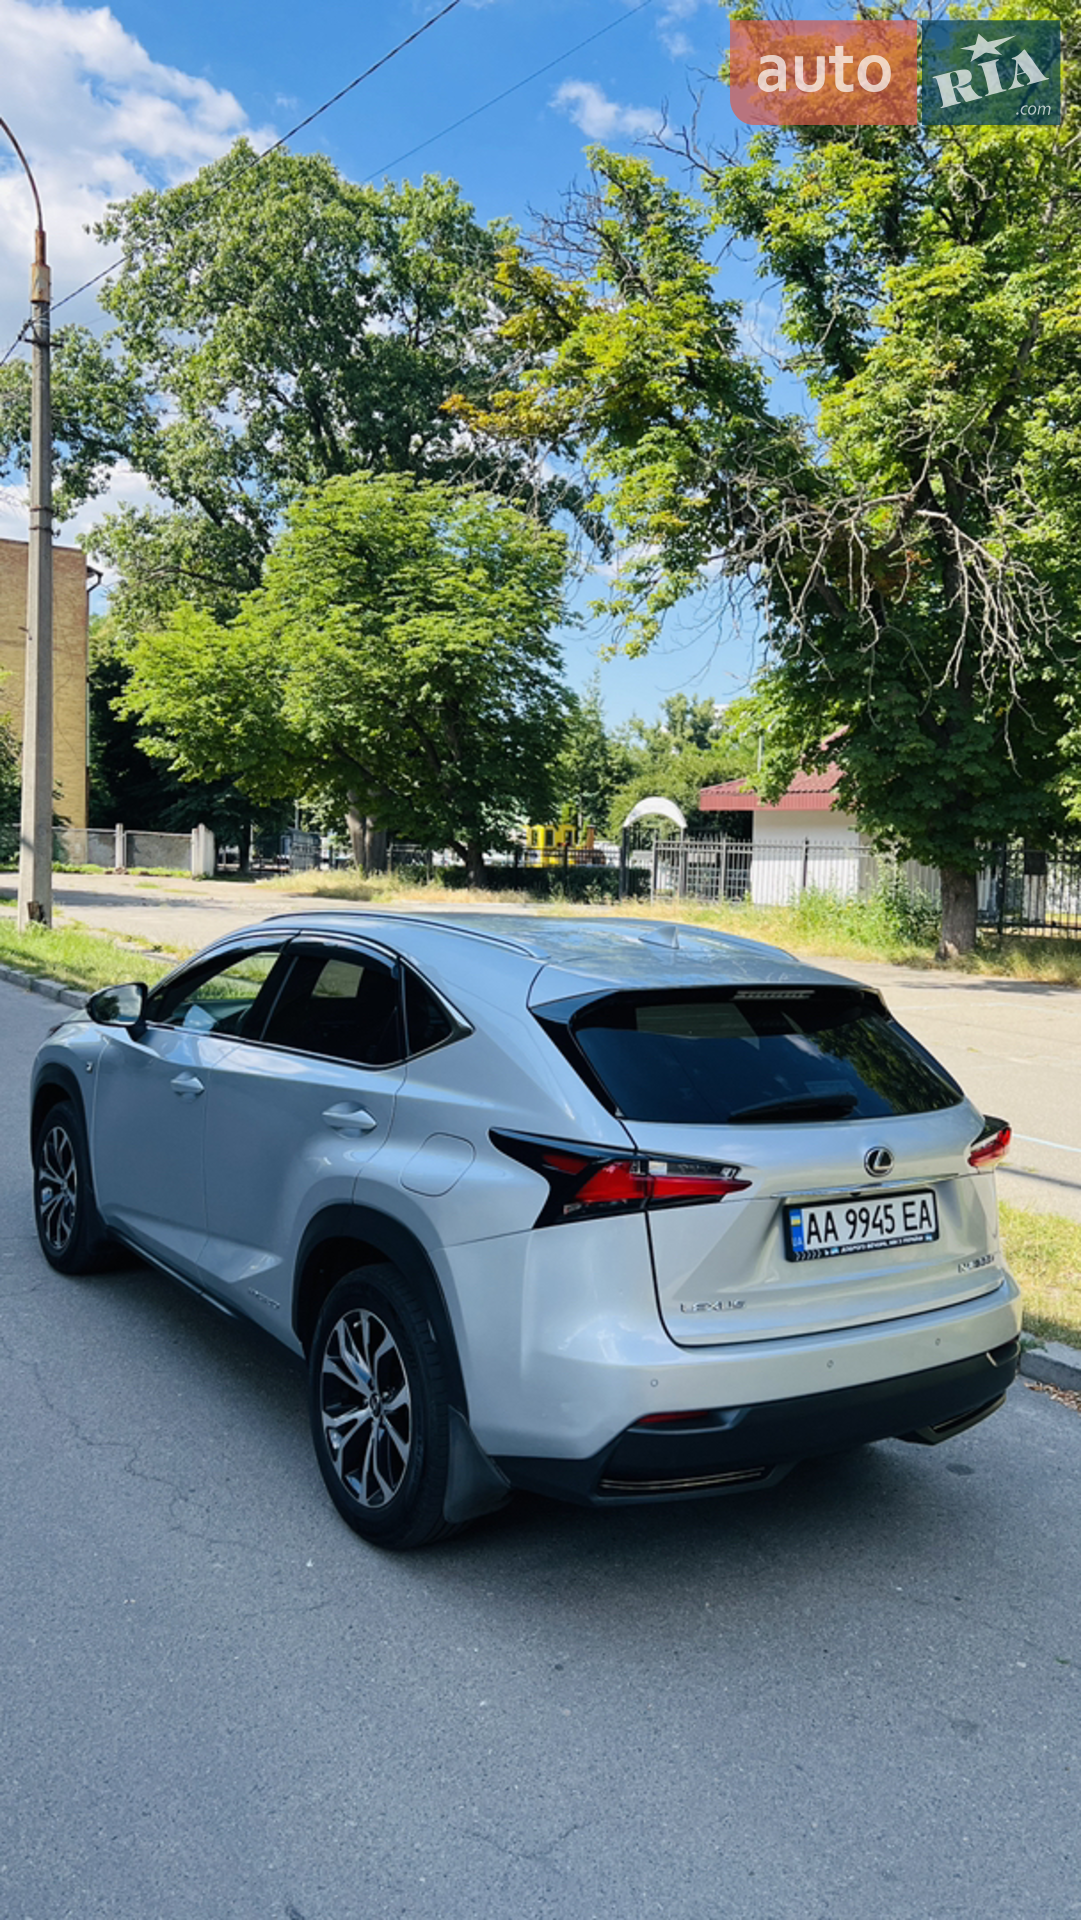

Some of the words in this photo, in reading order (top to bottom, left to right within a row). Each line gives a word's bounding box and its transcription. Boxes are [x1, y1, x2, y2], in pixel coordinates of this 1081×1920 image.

[807, 1210, 839, 1245] AA
[845, 1204, 895, 1240] 9945
[902, 1199, 932, 1232] EA
[680, 1300, 745, 1314] LEXUS
